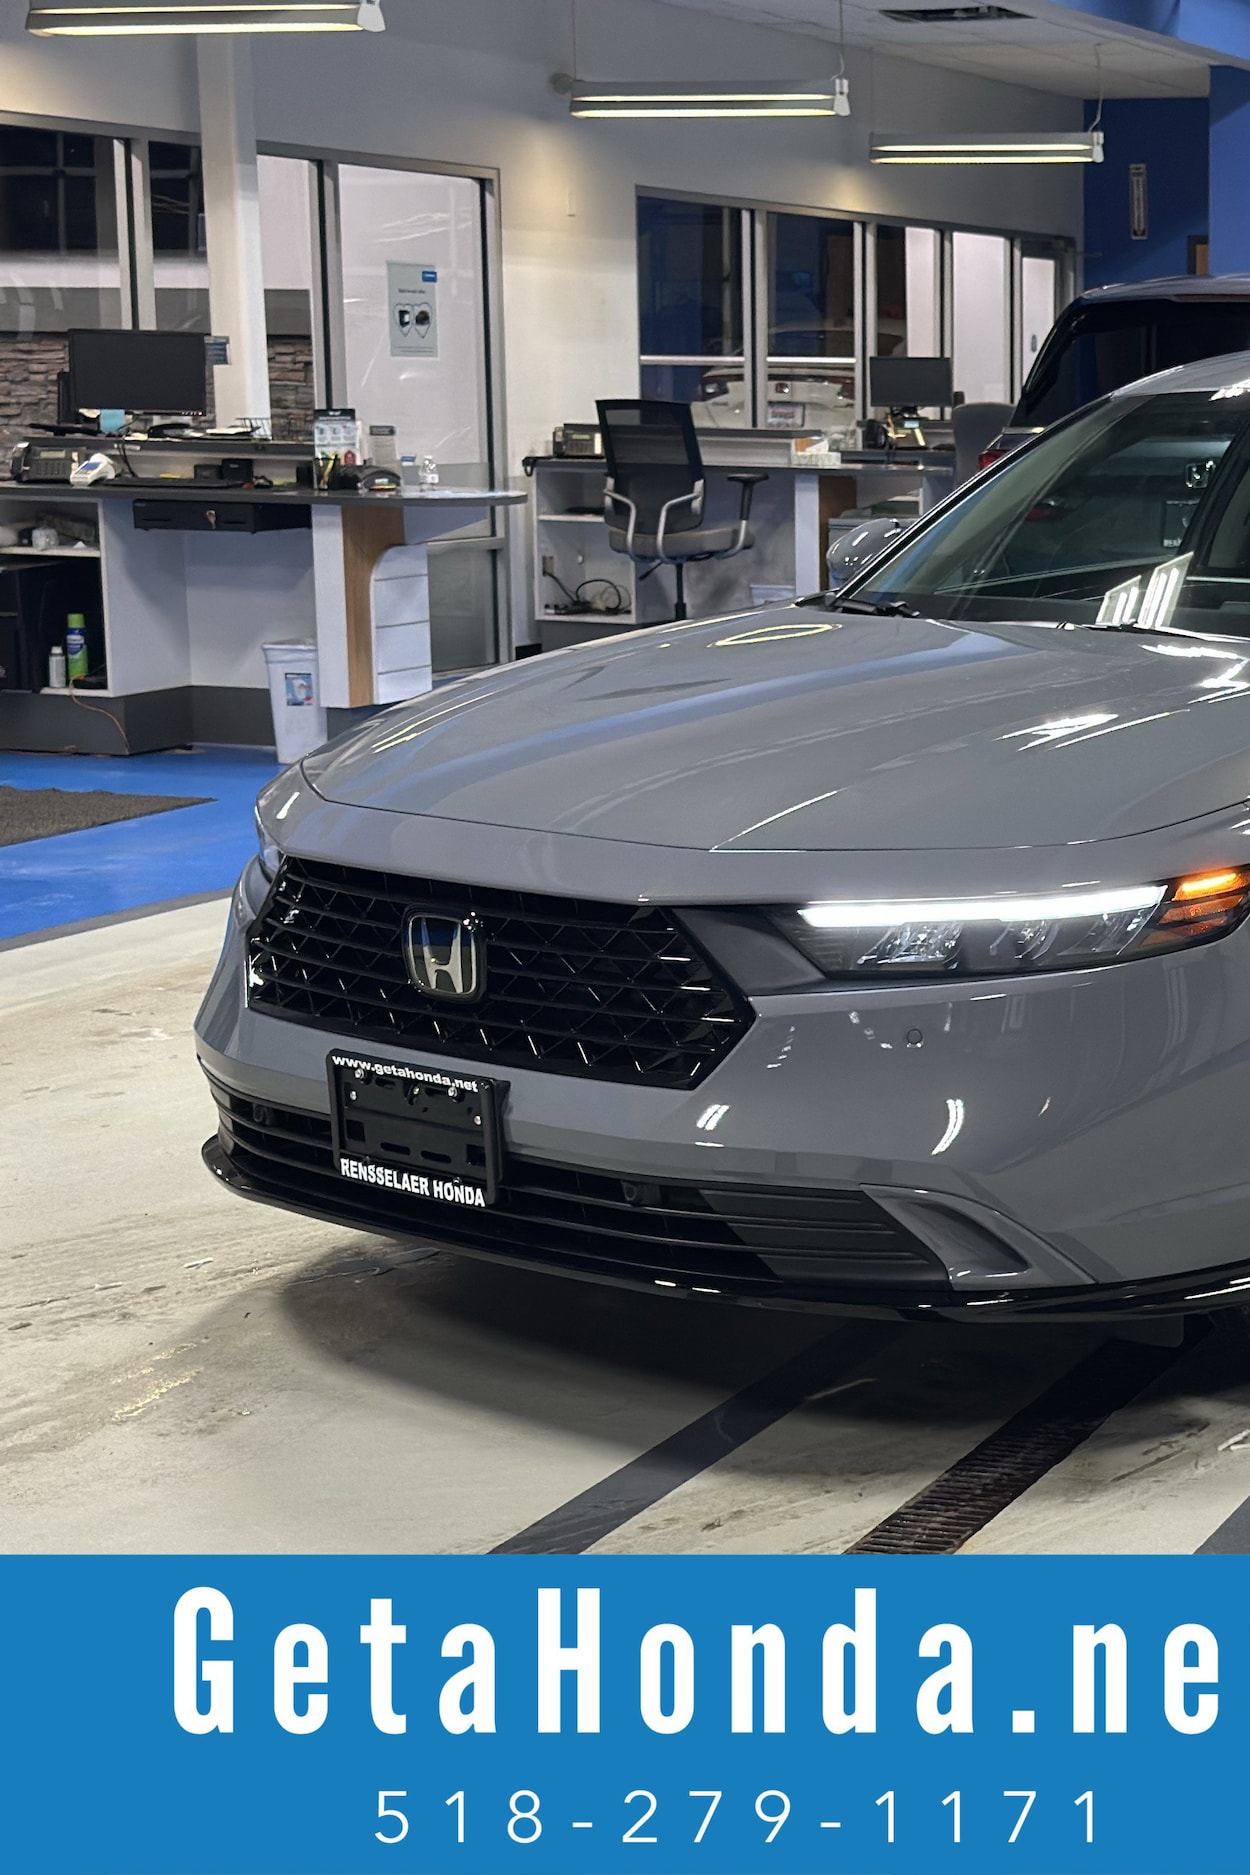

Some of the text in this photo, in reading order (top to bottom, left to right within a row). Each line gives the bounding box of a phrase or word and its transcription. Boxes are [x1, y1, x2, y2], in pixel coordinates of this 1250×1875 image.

[332, 1056, 478, 1093] www.getahonda.net
[340, 1158, 486, 1208] RENSSELAER HONDA
